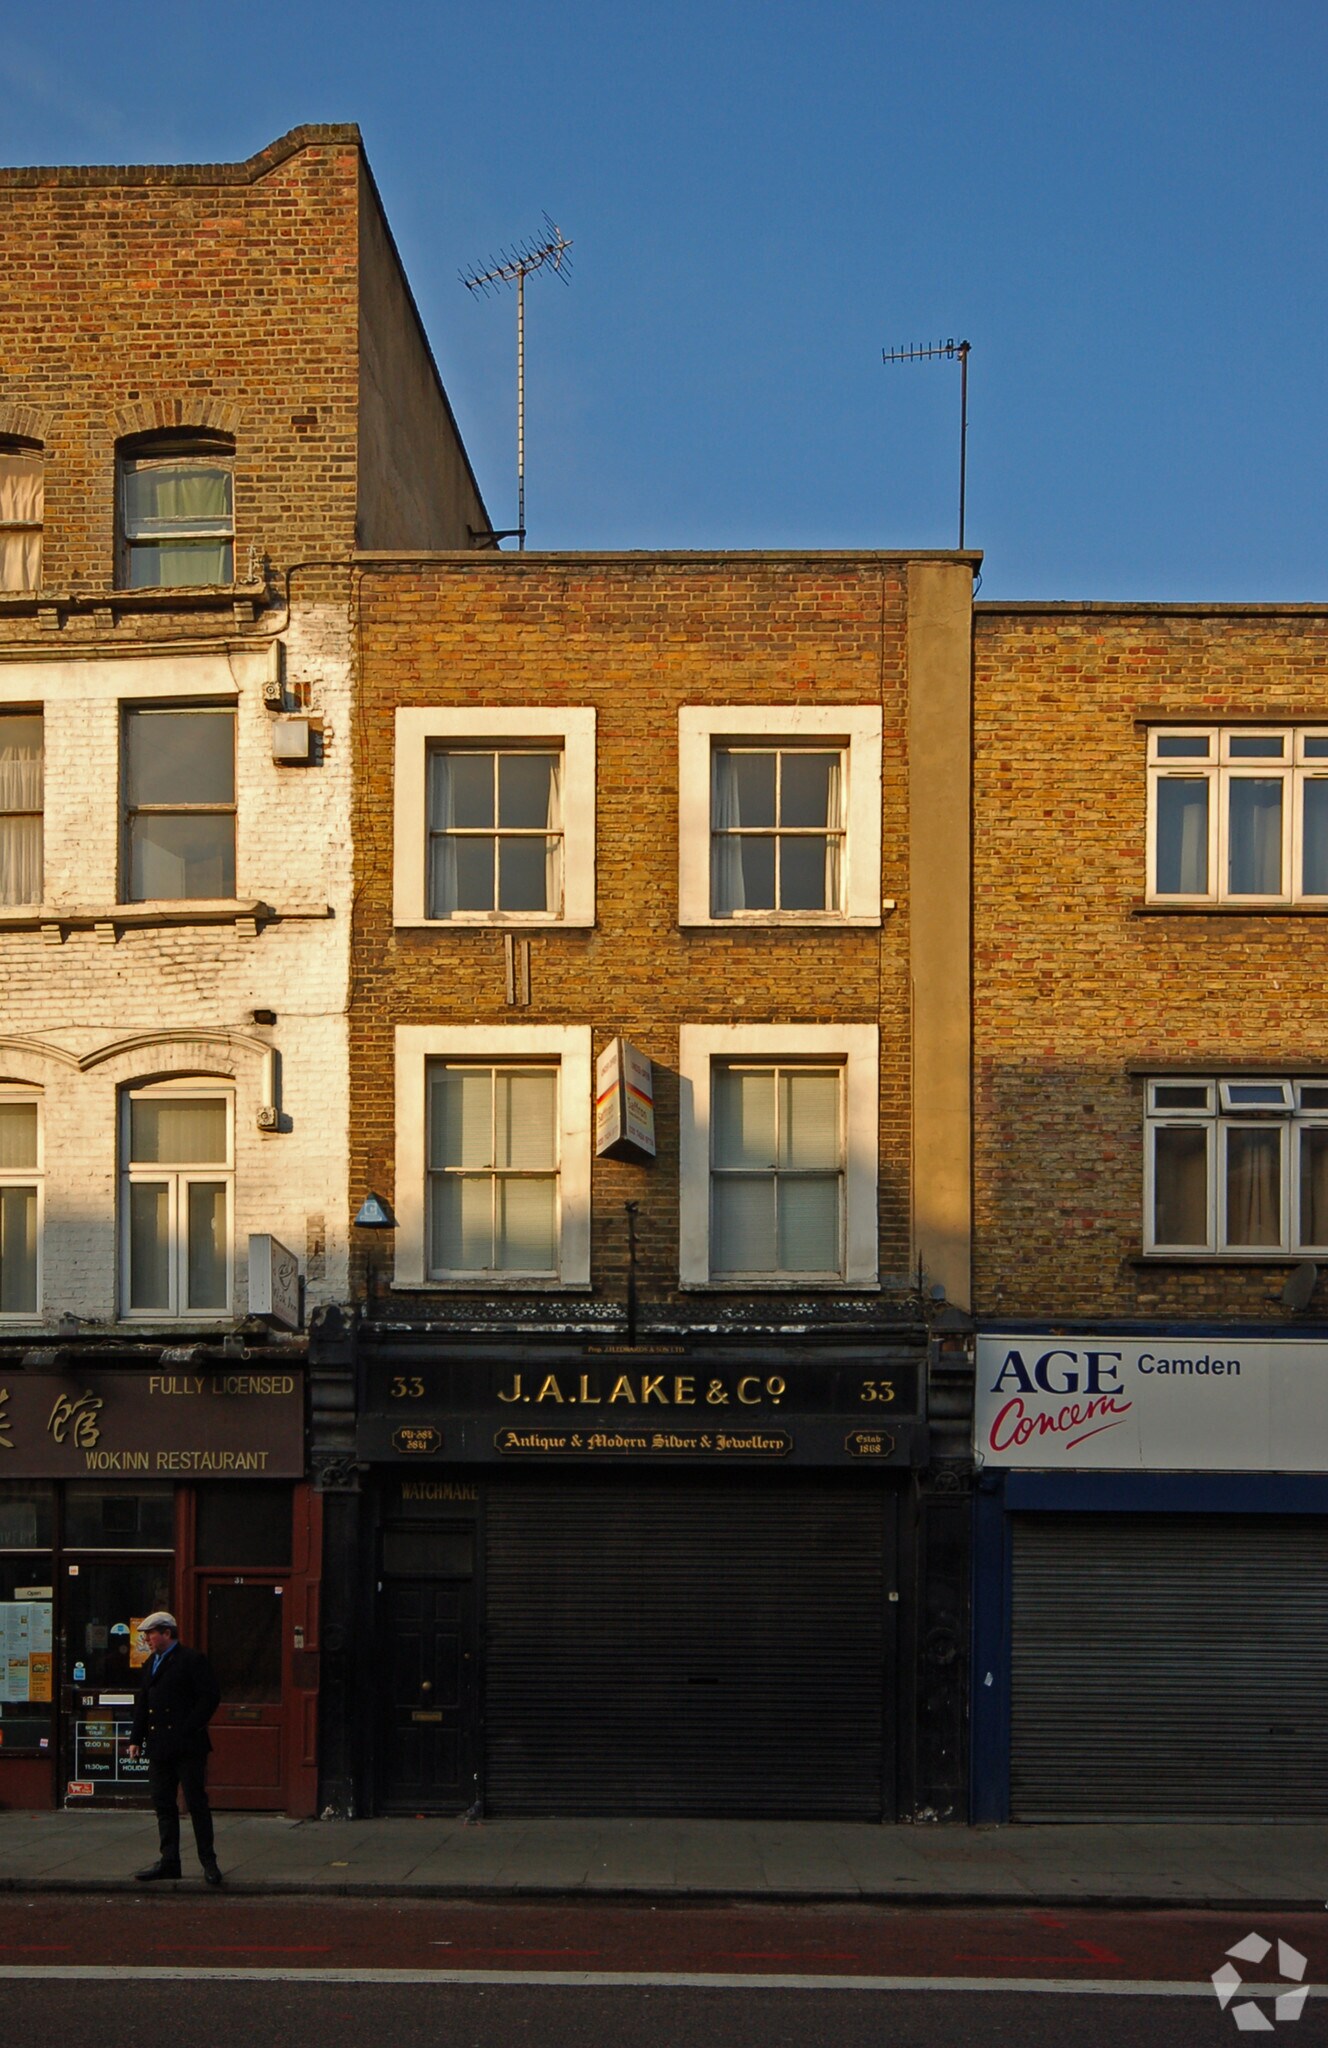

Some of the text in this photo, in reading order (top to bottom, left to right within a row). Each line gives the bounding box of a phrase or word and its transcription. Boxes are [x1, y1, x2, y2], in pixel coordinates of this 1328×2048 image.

[990, 1350, 1125, 1395] AGE
[1138, 1353, 1241, 1376] Camden
[150, 1376, 294, 1395] FULLY LICENSED
[390, 1376, 426, 1398] 33
[705, 1377, 730, 1405] &
[860, 1380, 896, 1402] 33
[989, 1395, 1133, 1451] Concern
[504, 1431, 785, 1452] Antique & Modern Silver & Jewellery
[86, 1452, 269, 1469] WOKINN RESTAURANT
[234, 1576, 244, 1584] 31
[27, 1589, 42, 1597] Open
